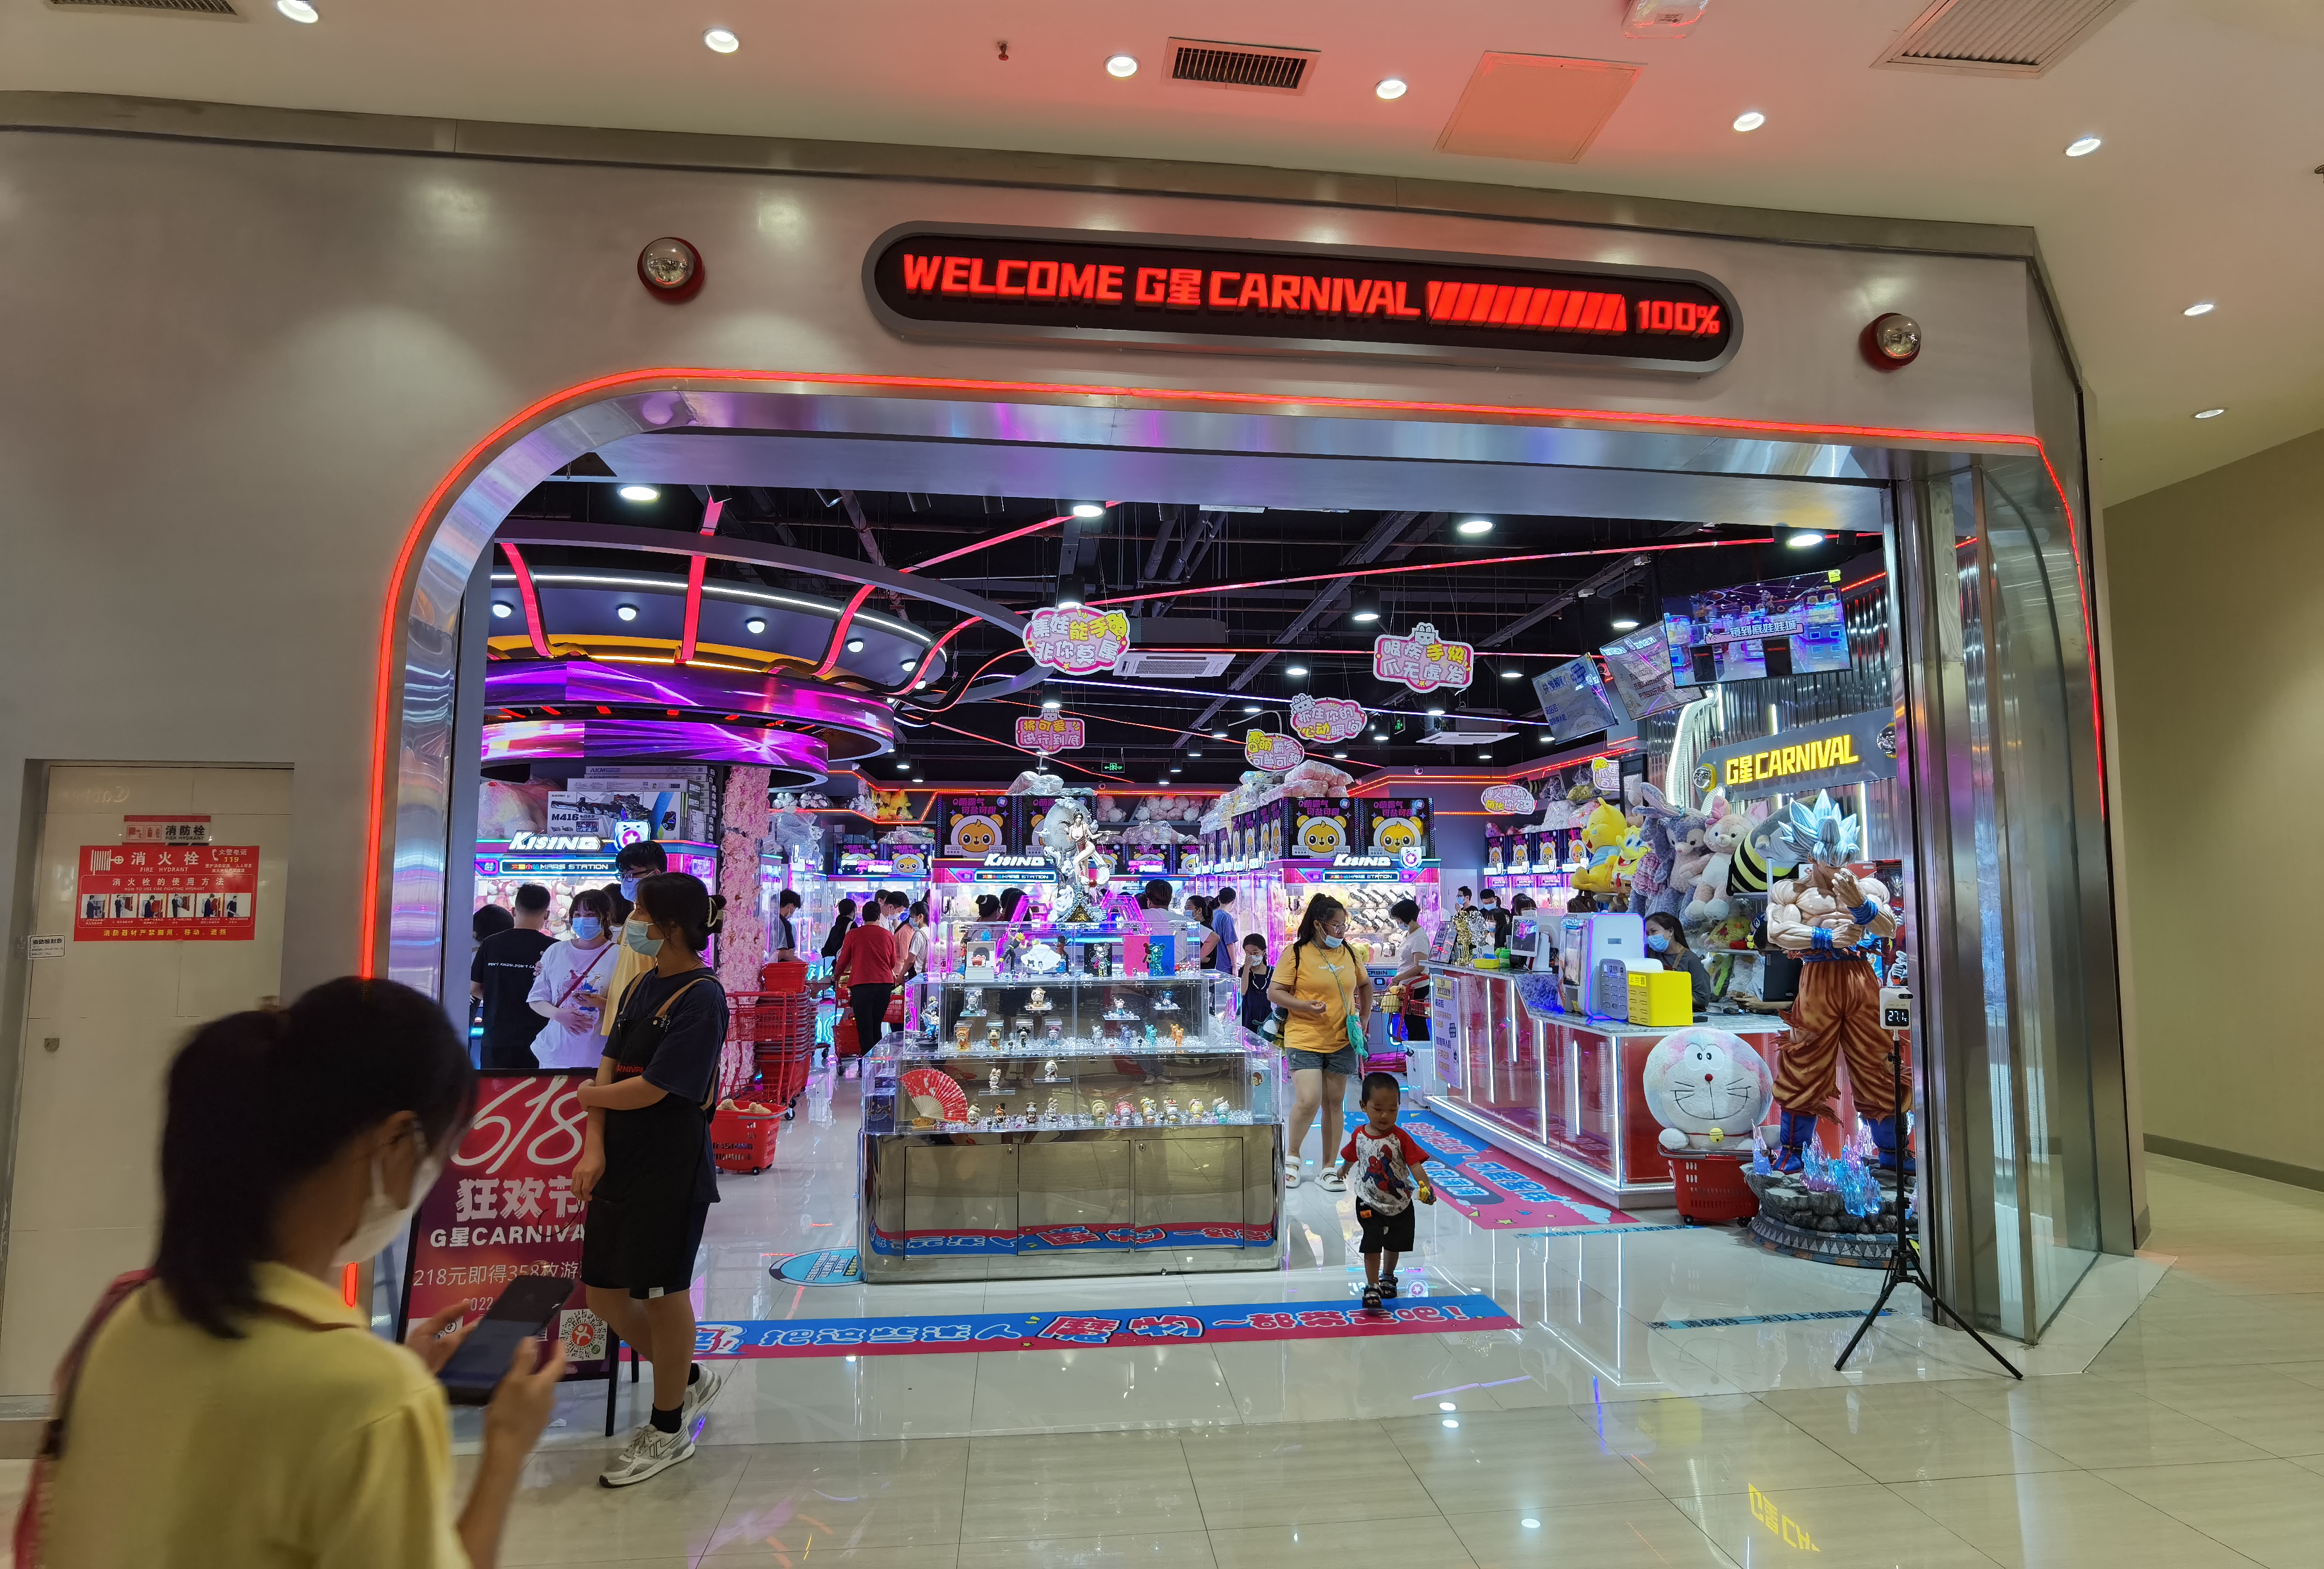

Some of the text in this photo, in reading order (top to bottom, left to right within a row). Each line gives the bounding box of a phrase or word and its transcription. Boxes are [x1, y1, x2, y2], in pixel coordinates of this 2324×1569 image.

[904, 254, 1125, 301] WELCOME
[1636, 300, 1720, 335] 100%
[1034, 639, 1120, 665] 非你莫属
[1023, 719, 1066, 733] 将可爱
[1023, 732, 1080, 746] 进行到底
[962, 806, 997, 815] 可盐可甜
[1307, 808, 1340, 816] 可盐可甜
[165, 824, 205, 835] 消防栓
[131, 850, 199, 866] 消火栓
[113, 878, 225, 887] 消火栓的使用方法
[450, 1075, 589, 1174] 618
[456, 1176, 585, 1222] 狂欢节
[413, 1260, 582, 1286] 218元即得358枚游
[463, 1297, 494, 1312] 022
